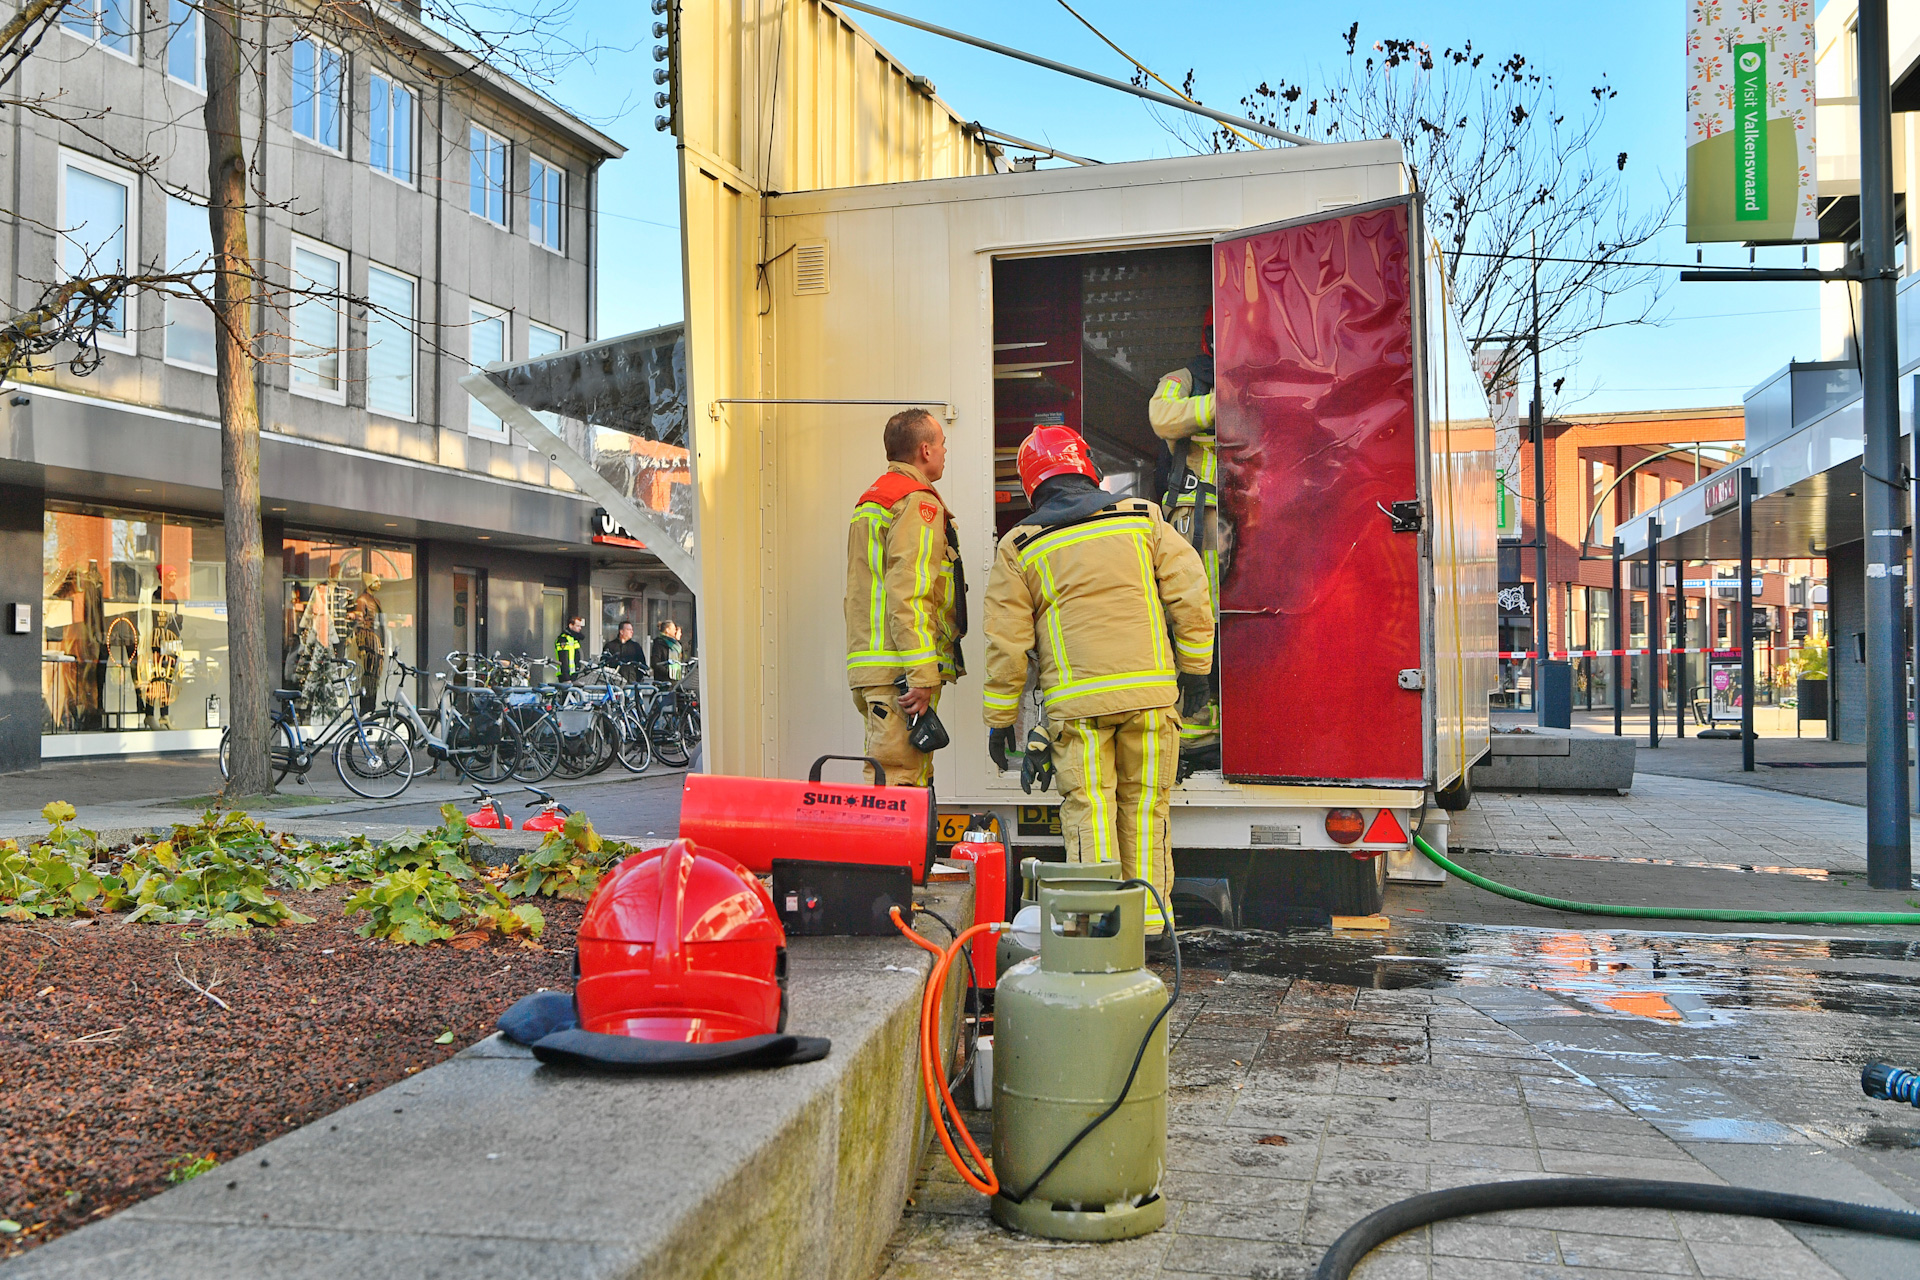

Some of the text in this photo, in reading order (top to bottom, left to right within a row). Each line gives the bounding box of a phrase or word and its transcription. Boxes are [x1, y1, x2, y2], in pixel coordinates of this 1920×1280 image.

[1743, 76, 1760, 211] Visit Valkenswaard
[803, 792, 907, 812] Sun Heat
